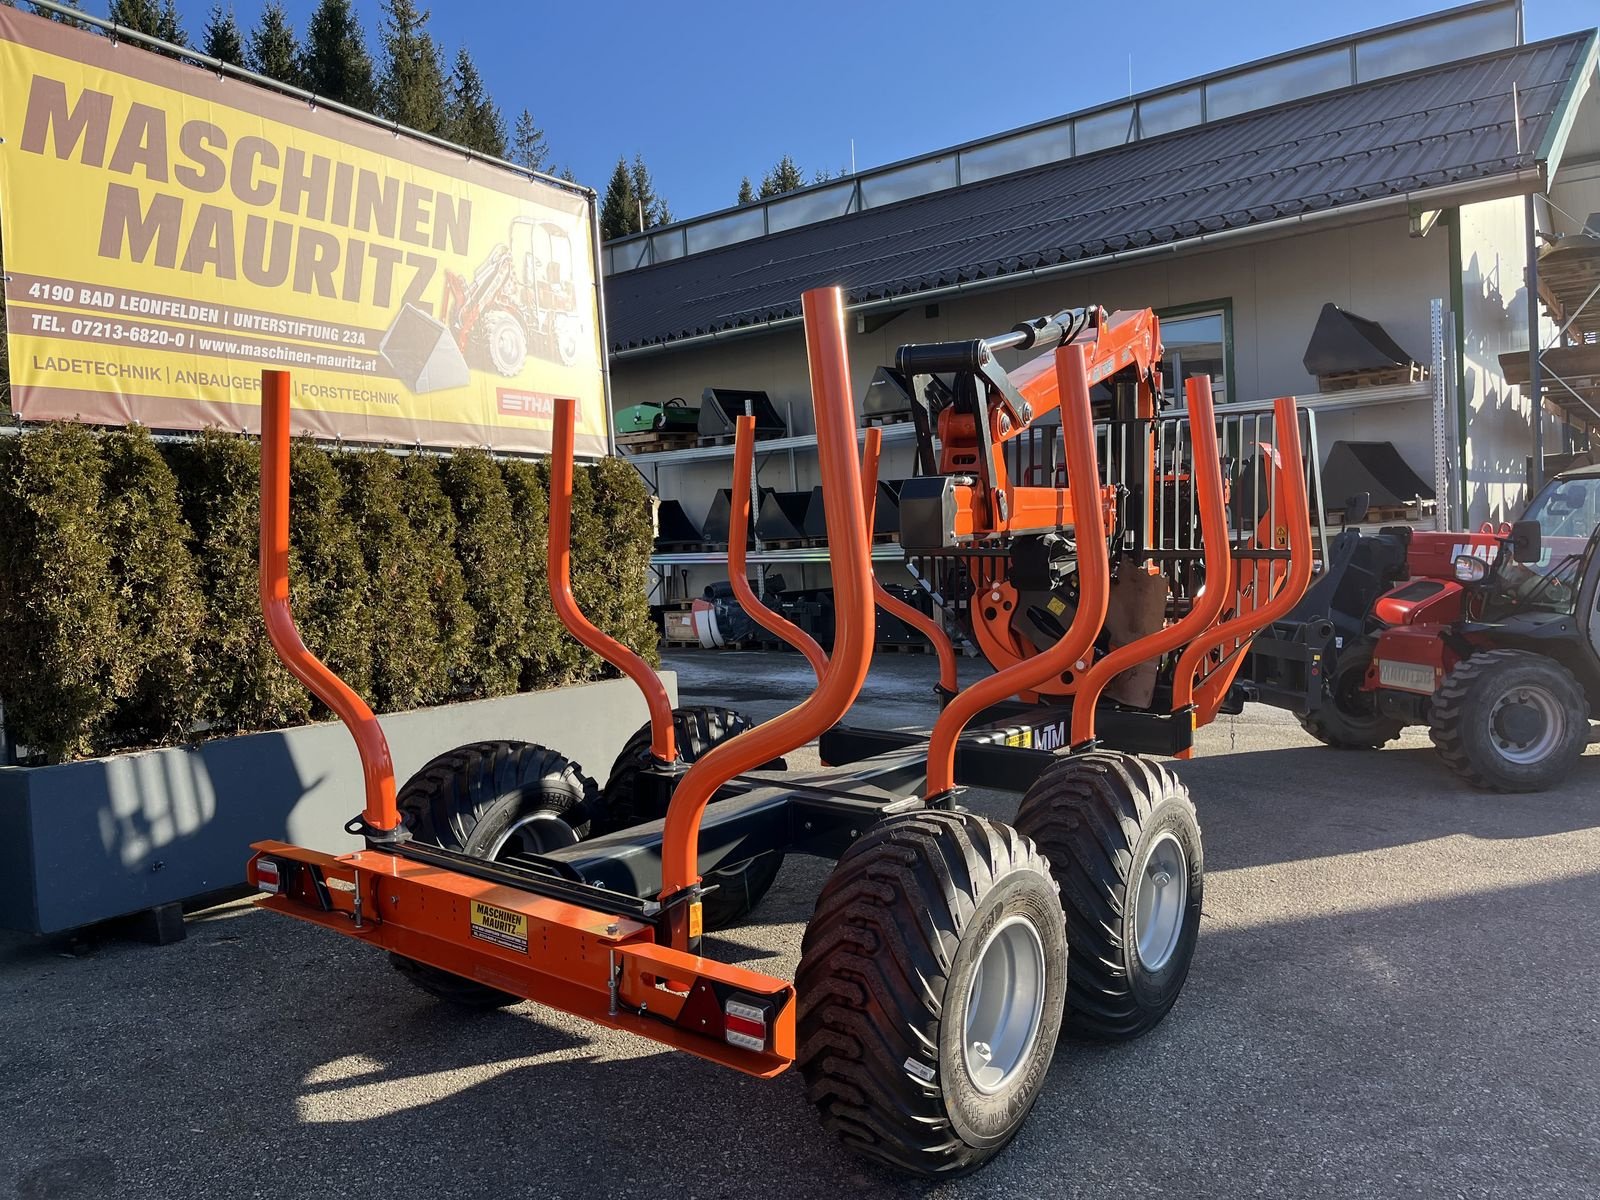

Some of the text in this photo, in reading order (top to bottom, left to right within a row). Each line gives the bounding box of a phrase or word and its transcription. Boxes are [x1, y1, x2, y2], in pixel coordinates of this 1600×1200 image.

[20, 74, 472, 256] MASCHINEN
[98, 182, 438, 310] MAURITZ
[29, 283, 366, 345] 4190 BAD LEONFELDEN UNTERSTIFTUNG 23A
[31, 314, 377, 372] TEL. 07213-6820-0 www.maschinen-mauritz.at
[33, 355, 400, 405] LADETECHNIK ANBAUGER FORSTTECHNIK
[1034, 721, 1065, 750] MTM
[477, 904, 522, 925] MASCHINEN
[483, 916, 517, 934] MAURITZ
